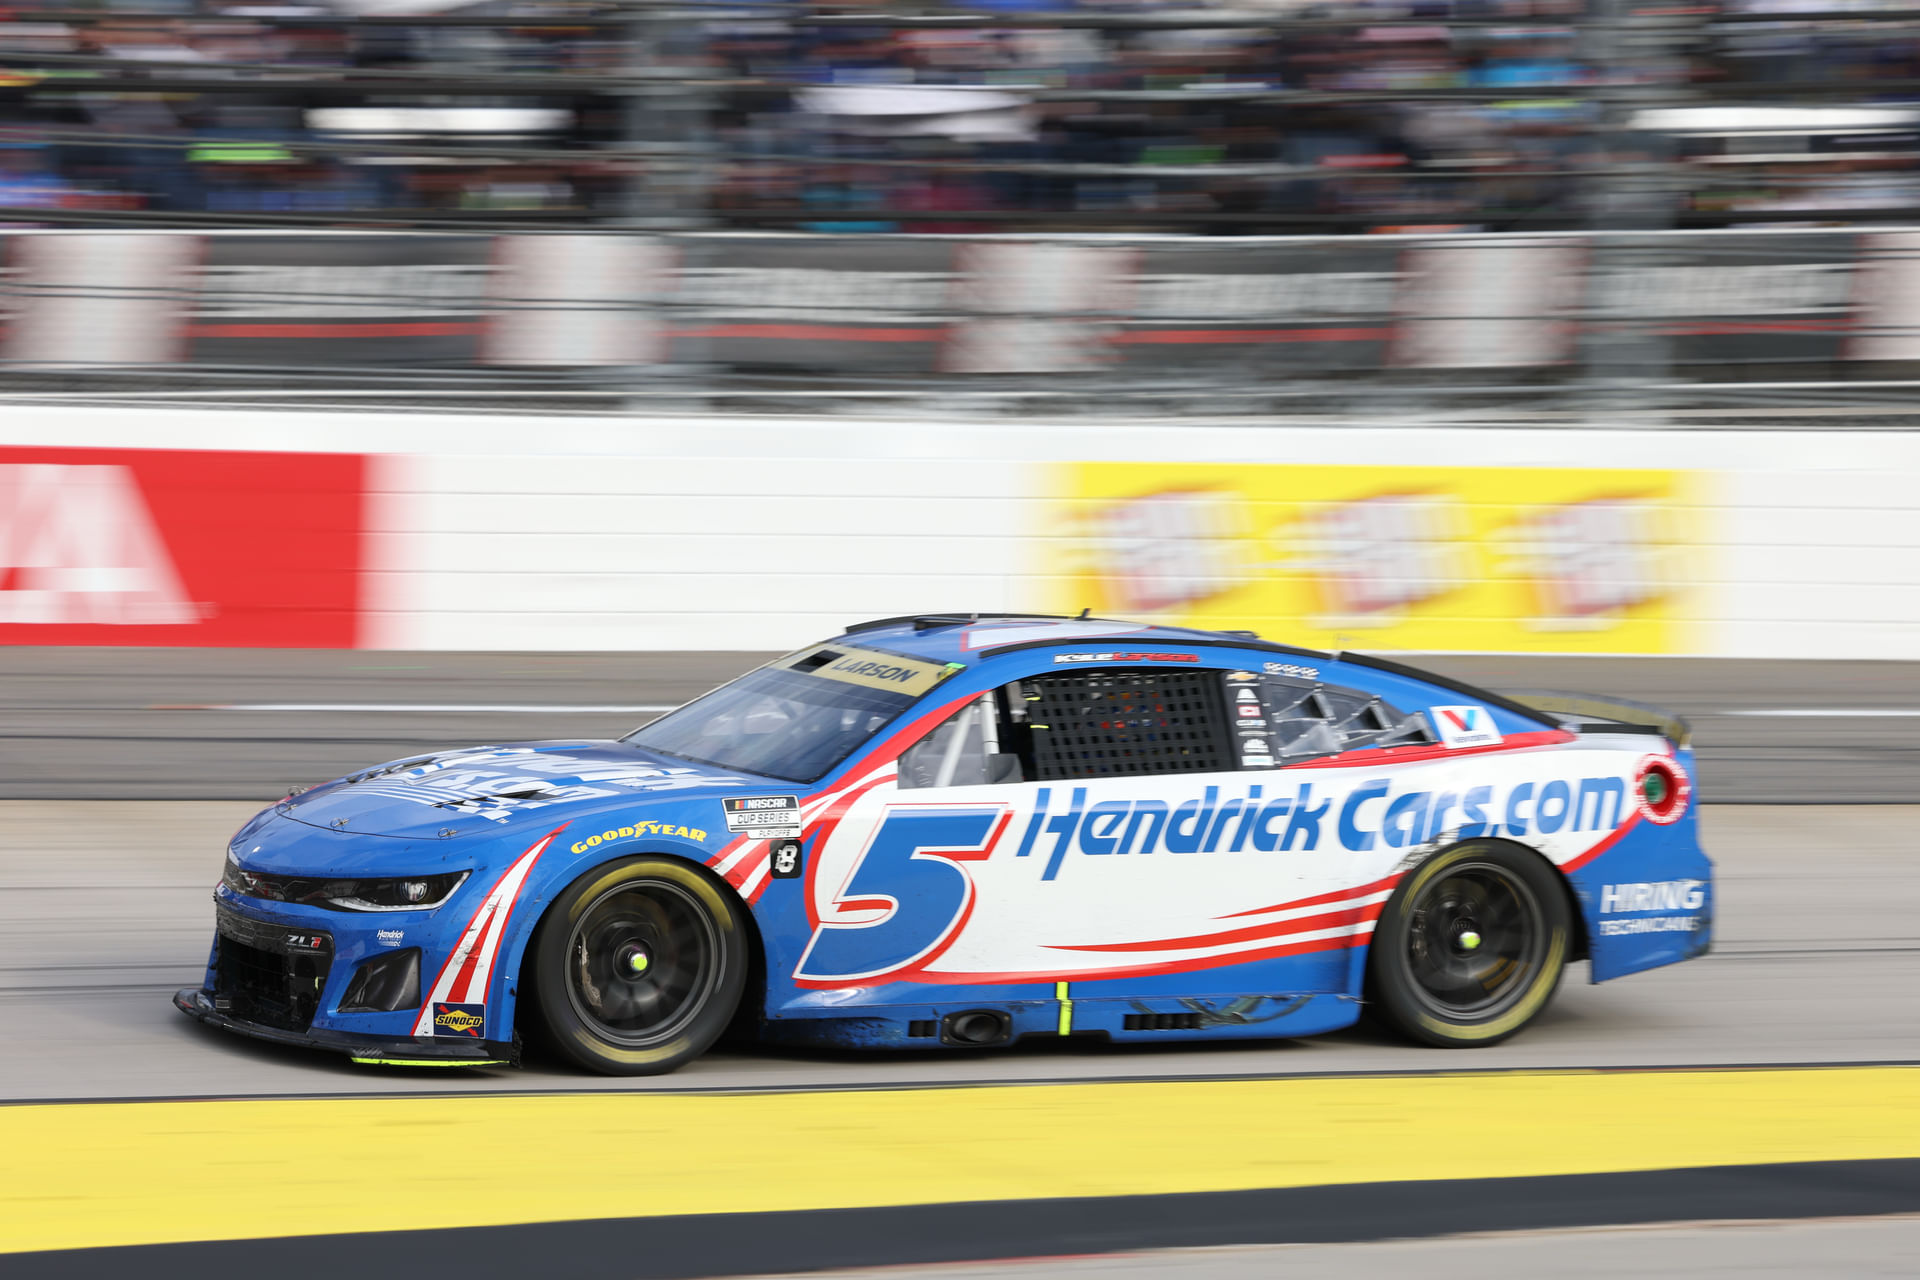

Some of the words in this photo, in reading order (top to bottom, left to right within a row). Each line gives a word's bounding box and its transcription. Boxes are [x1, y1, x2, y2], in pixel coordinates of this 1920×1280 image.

[831, 658, 920, 683] LARSON
[747, 798, 787, 809] NASCAR
[737, 813, 756, 824] CUP
[757, 812, 790, 823] SERIES
[570, 820, 708, 854] GOODYEAR
[779, 845, 798, 873] 8
[792, 802, 1015, 987] 5
[1600, 879, 1705, 914] HIRING
[437, 1015, 481, 1026] SUNOCO
